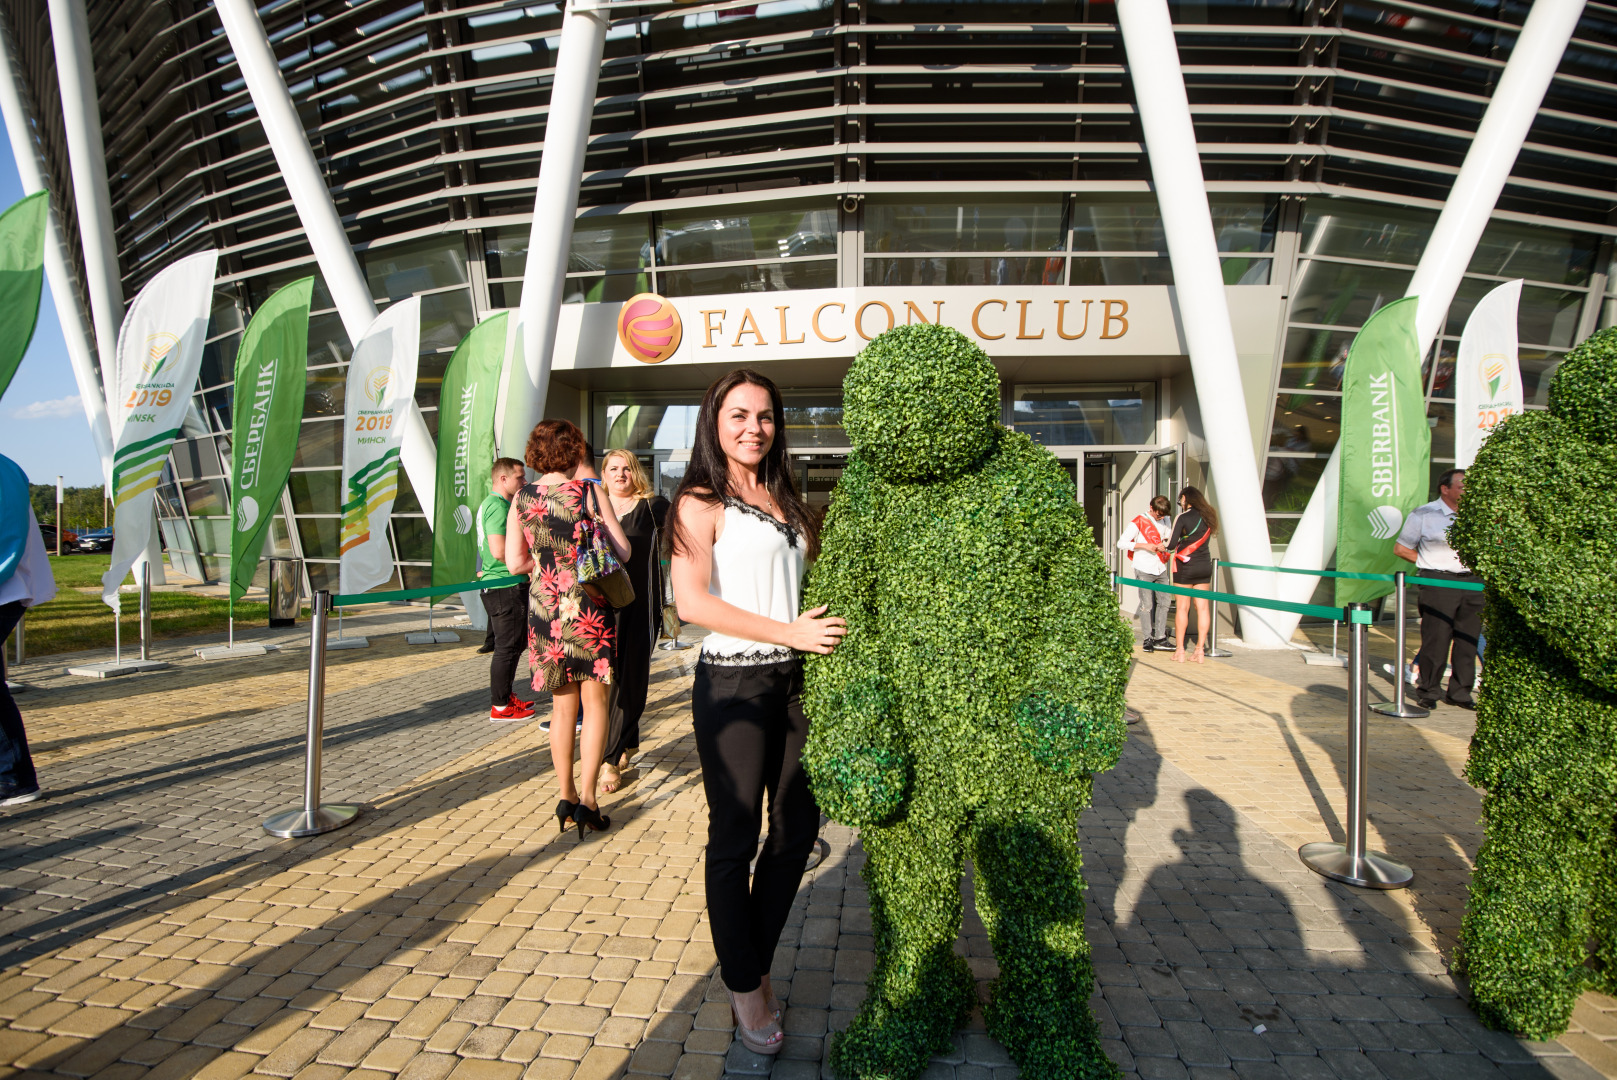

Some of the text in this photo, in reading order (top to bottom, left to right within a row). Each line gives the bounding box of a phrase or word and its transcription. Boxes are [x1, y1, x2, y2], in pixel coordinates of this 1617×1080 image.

[700, 298, 1130, 348] FALCON CLUB
[125, 389, 173, 408] 2019
[355, 415, 393, 431] 2019
[1477, 408, 1514, 428] 201
[240, 359, 275, 490] СБЕРБАНК
[454, 383, 473, 498] SBERBANK
[1369, 371, 1394, 498] SBERBANK
